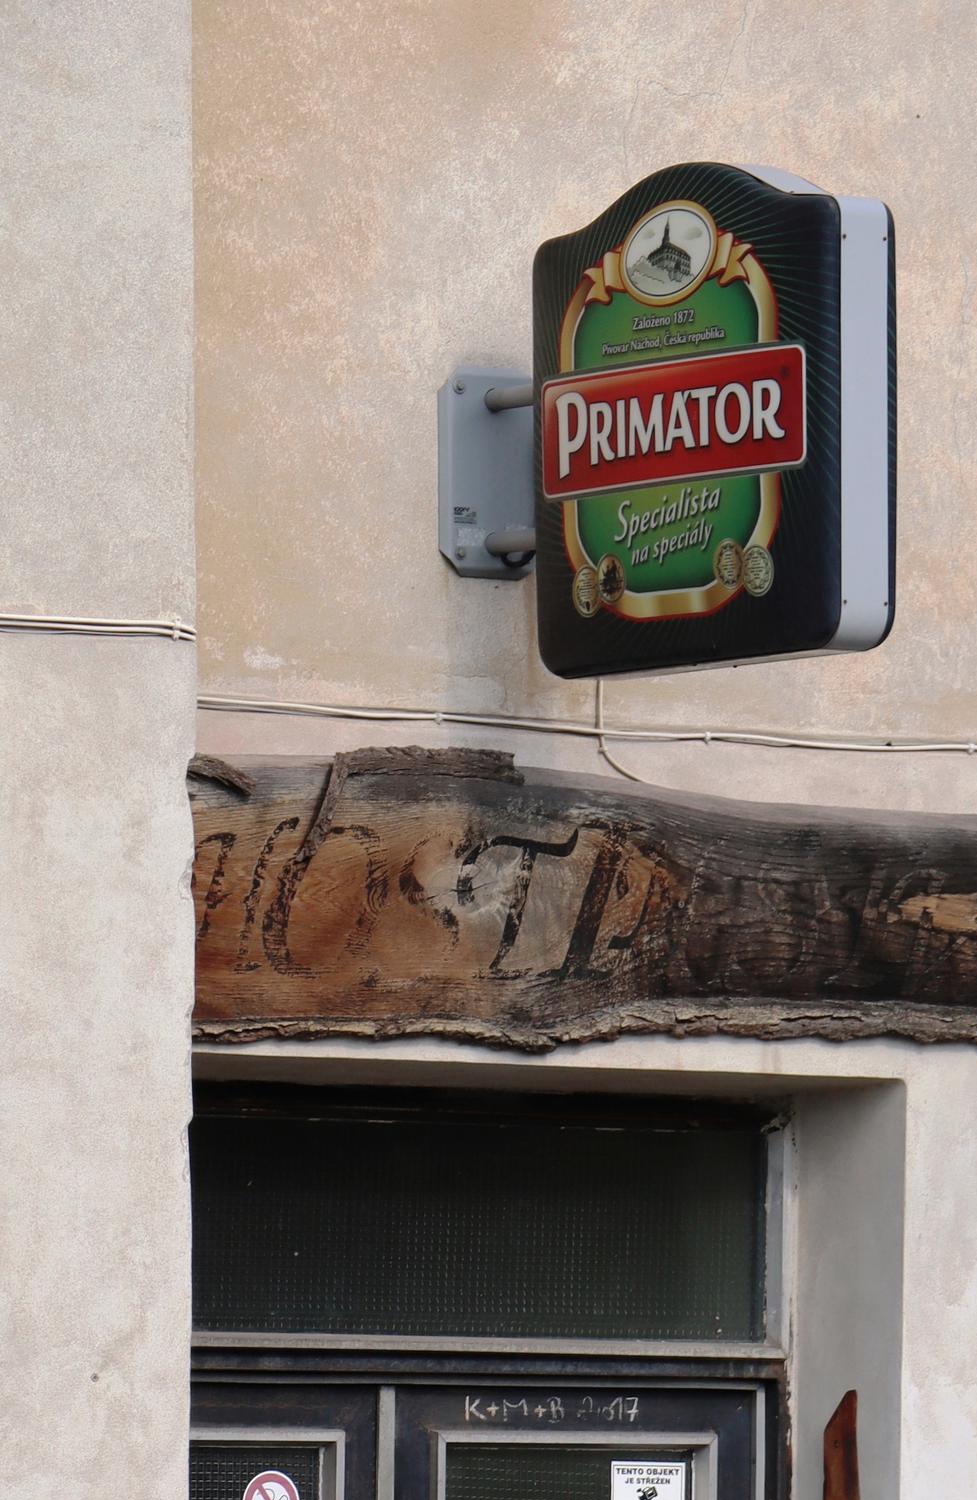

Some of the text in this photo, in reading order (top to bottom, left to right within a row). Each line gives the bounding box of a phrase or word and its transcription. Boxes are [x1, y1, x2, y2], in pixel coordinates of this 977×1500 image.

[632, 309, 695, 330] Založeno 1872
[602, 343, 629, 355] Pivovar
[687, 327, 726, 345] republika
[555, 378, 786, 480] PRIMÁTOR
[614, 486, 721, 549] Specialista
[631, 518, 714, 566] na speciály
[616, 1467, 680, 1476] TENTO OBJEKT
[625, 1476, 671, 1485] JE STŘEŽEN
